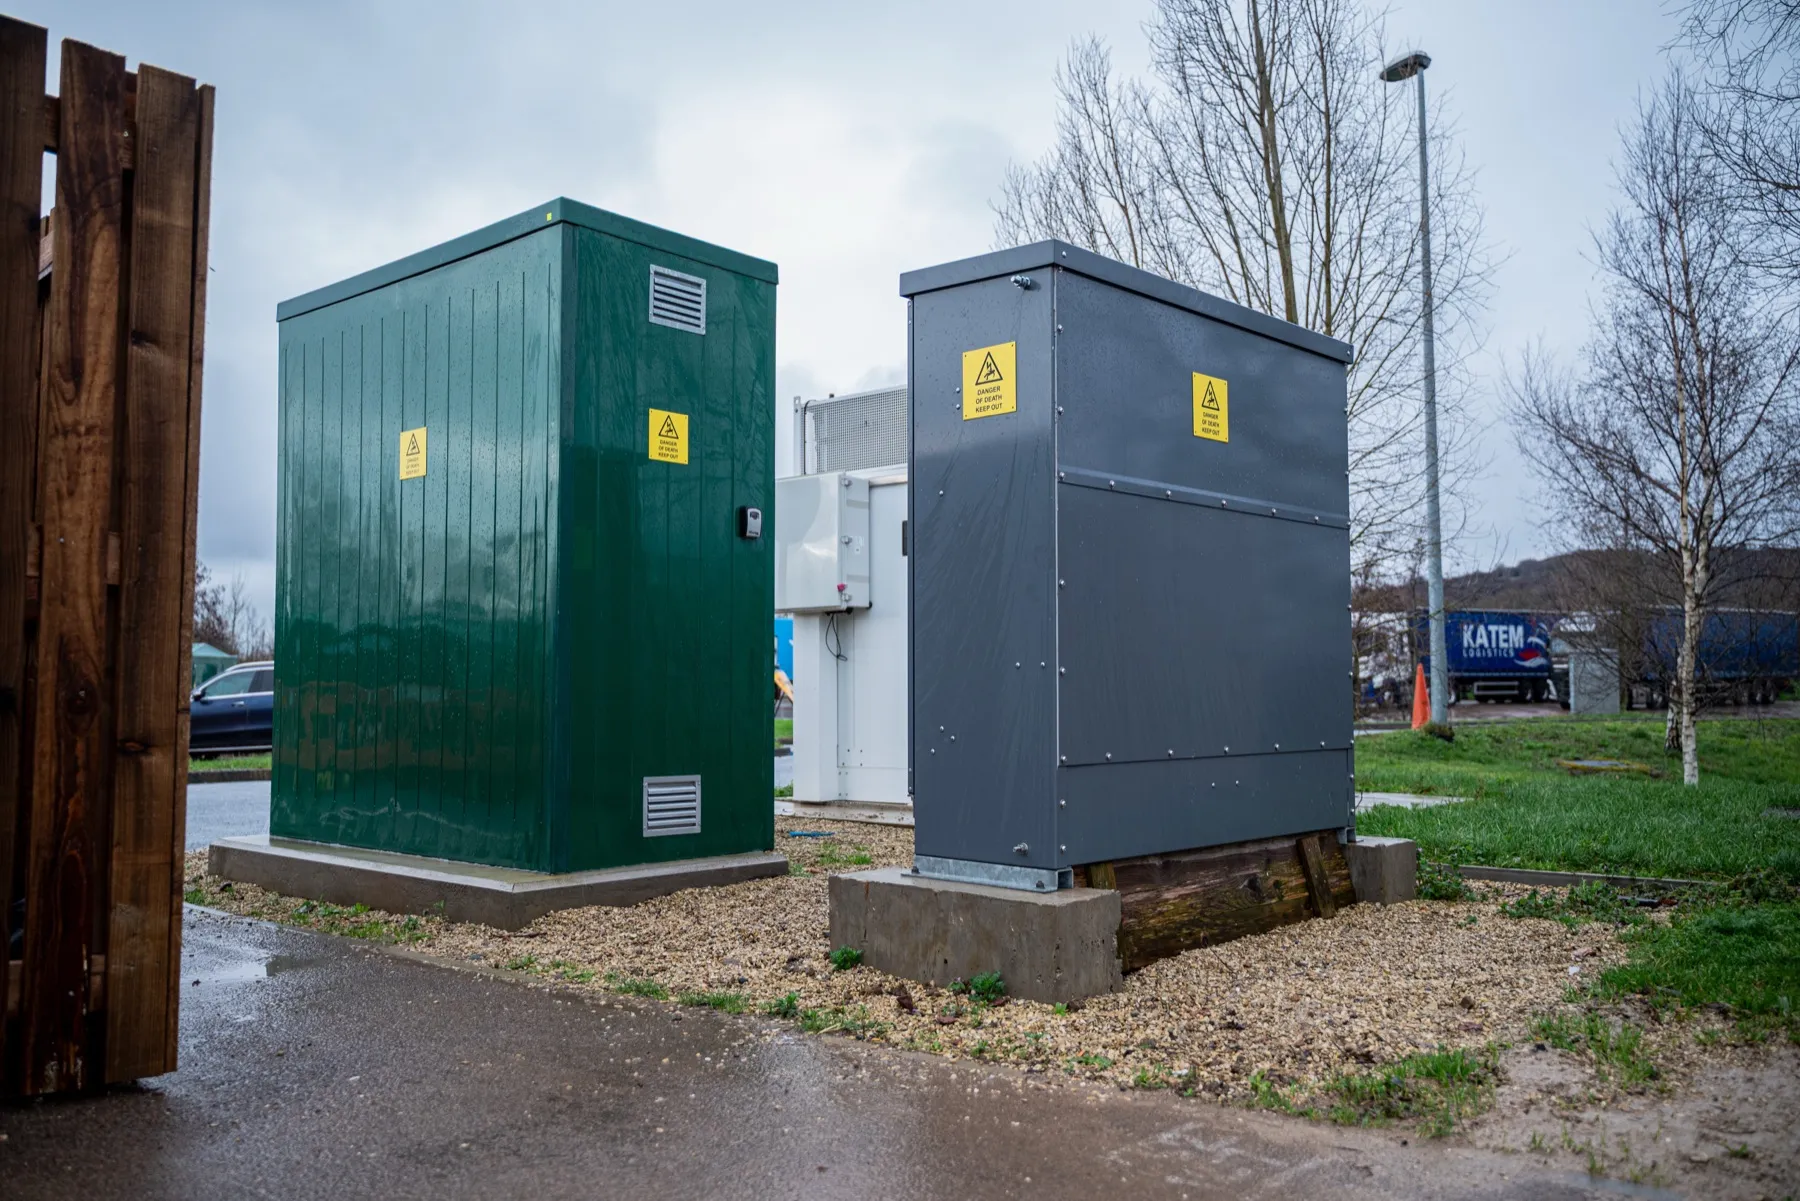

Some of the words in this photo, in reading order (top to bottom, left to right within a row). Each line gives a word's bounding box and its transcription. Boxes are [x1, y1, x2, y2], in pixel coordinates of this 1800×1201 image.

[977, 386, 1000, 396] DANGER
[984, 394, 1002, 402] DEATH
[991, 402, 1002, 410] OUT
[1202, 412, 1218, 420] DANGER
[1462, 624, 1524, 648] KATEM
[1462, 648, 1514, 658] LOGISTICS
